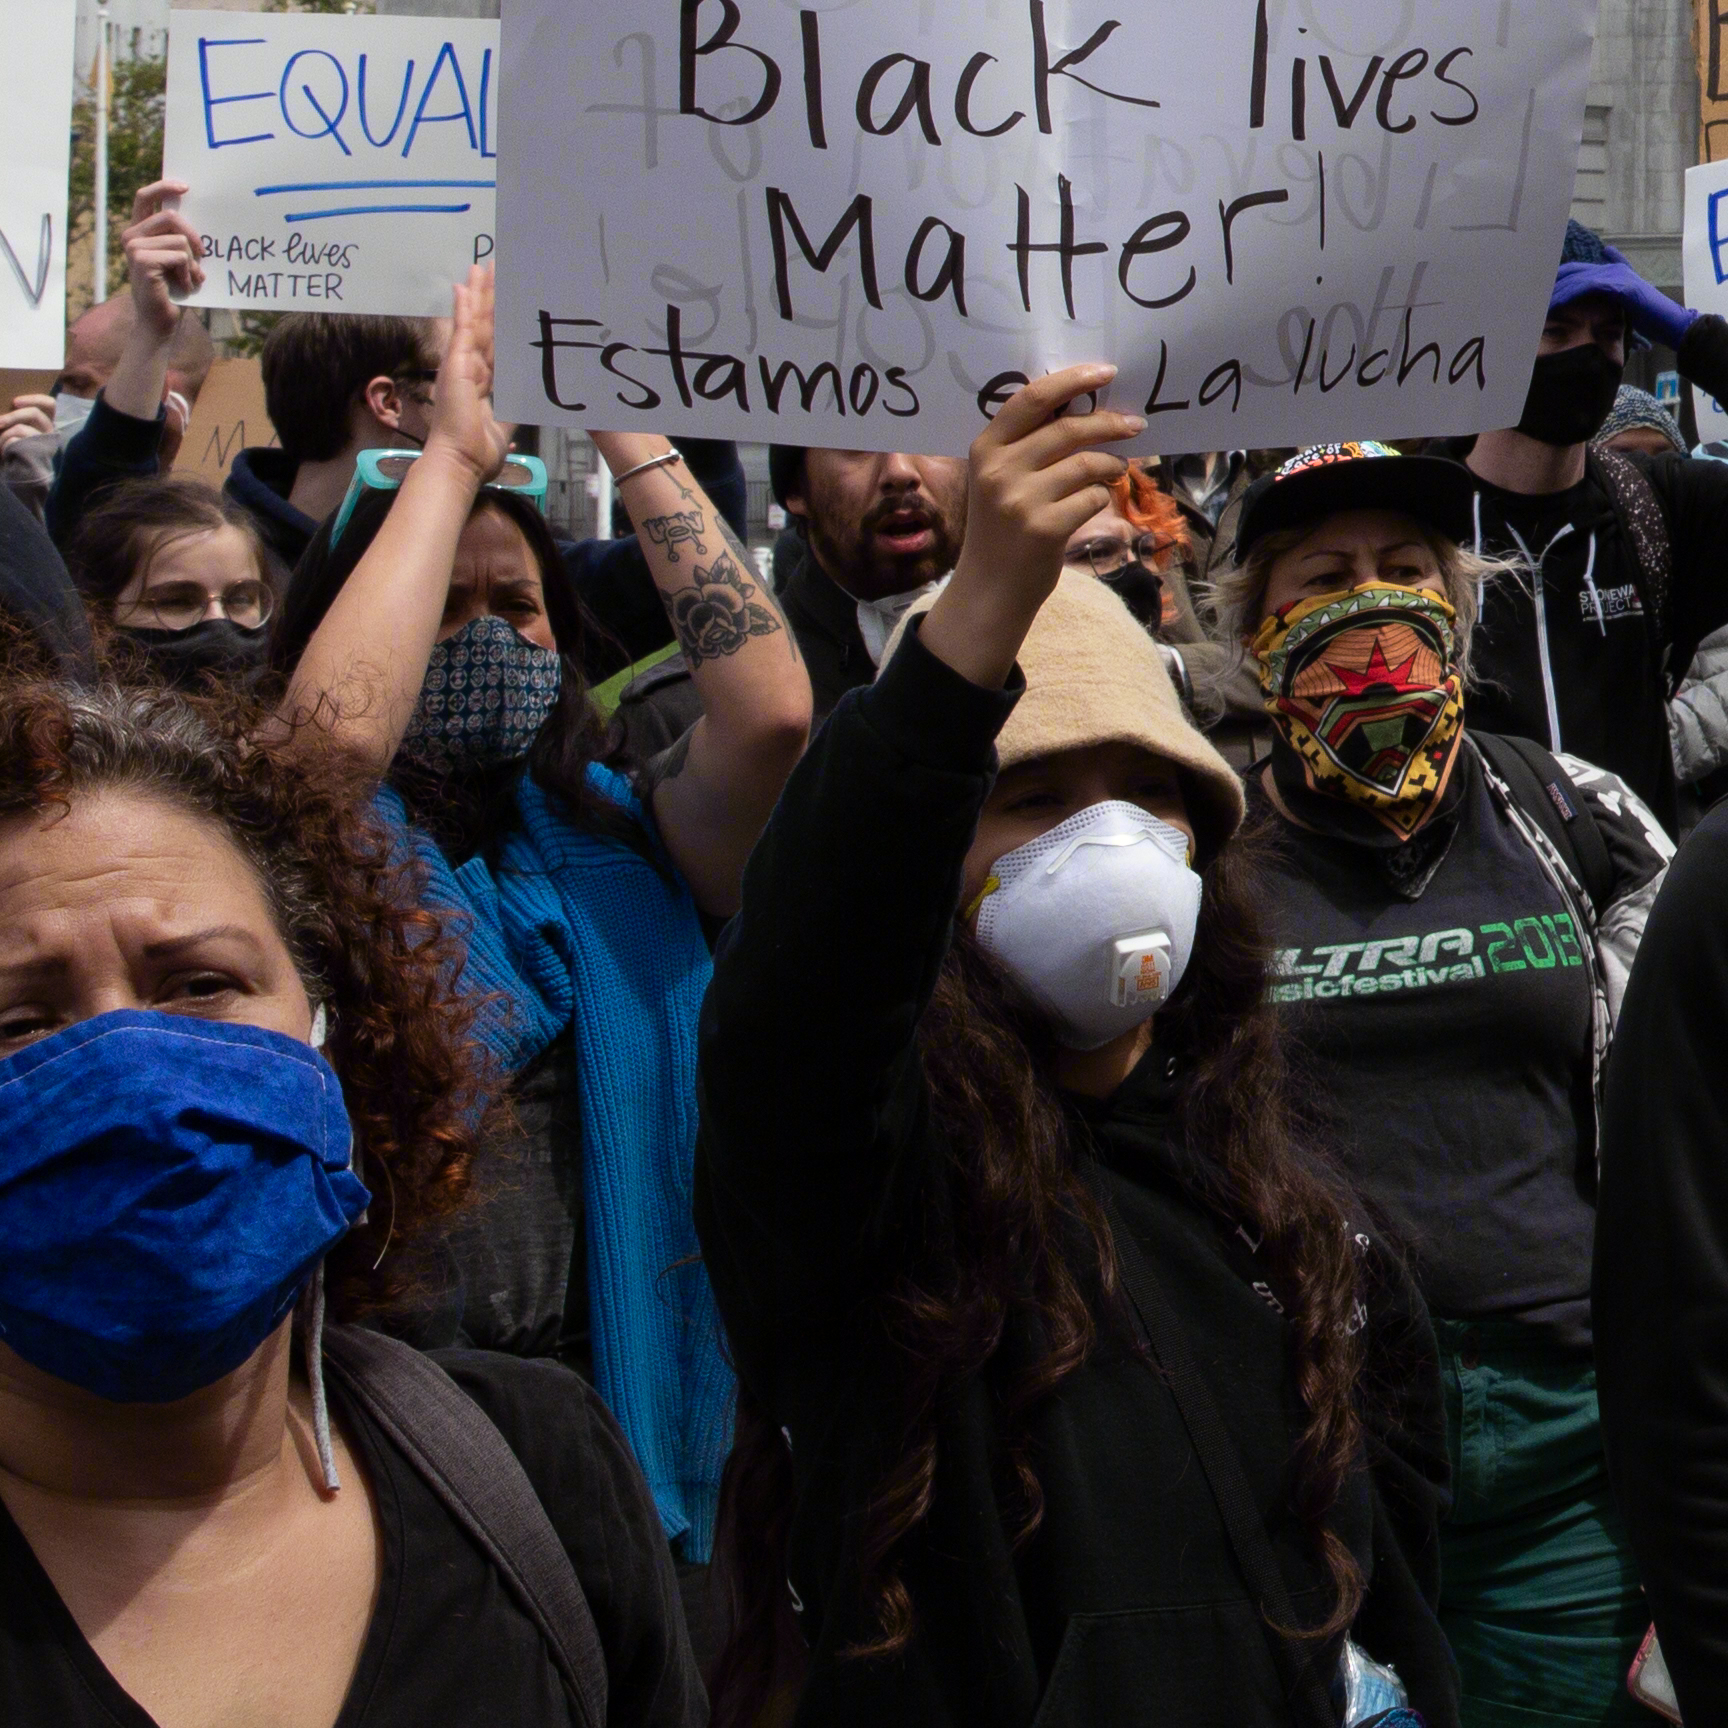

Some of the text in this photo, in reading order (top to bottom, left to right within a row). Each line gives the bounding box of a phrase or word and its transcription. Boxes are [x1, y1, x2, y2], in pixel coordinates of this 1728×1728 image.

[200, 232, 359, 269] BLACK lives
[765, 151, 1327, 321] Matter!
[228, 270, 344, 301] MATTER
[528, 305, 921, 418] Estamos
[1144, 338, 1243, 415] La
[1295, 306, 1487, 397] lucha
